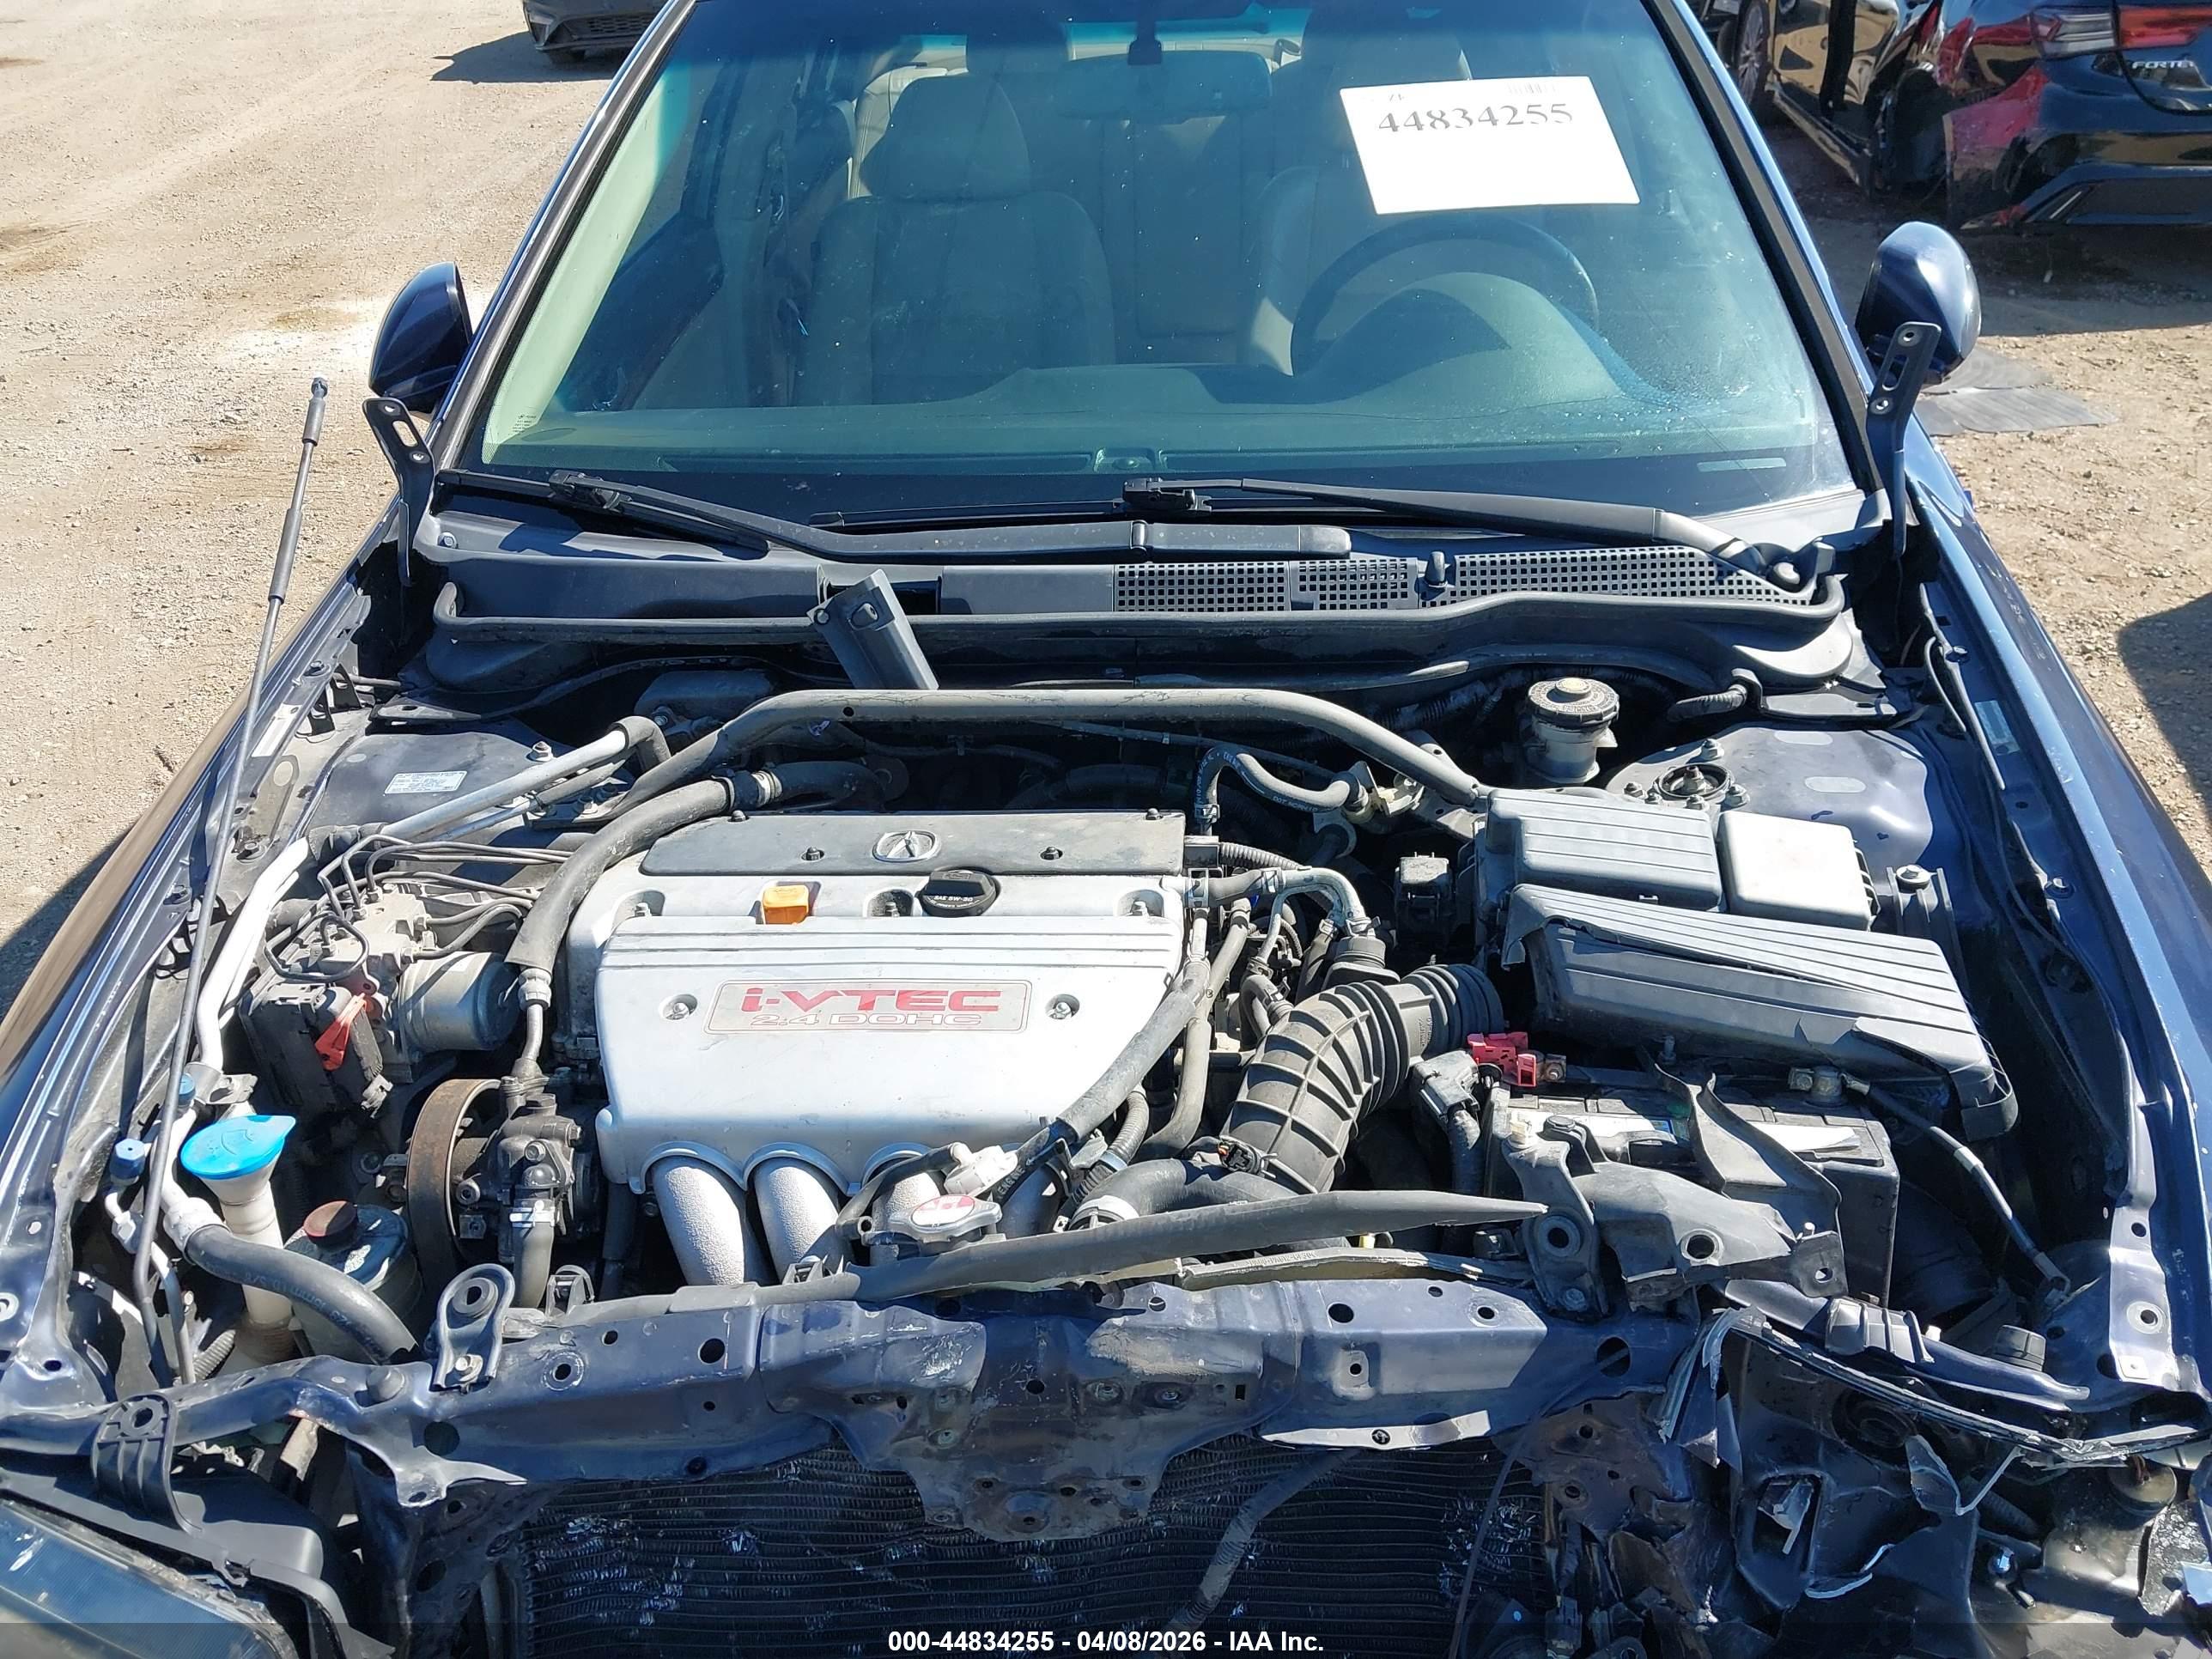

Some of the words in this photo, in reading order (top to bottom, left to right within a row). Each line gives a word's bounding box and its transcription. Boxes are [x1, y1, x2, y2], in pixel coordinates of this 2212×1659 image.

[1379, 103, 1573, 132] 44834255
[741, 988, 1002, 1012] i-VTEC
[750, 1013, 820, 1026] 2.4
[830, 1012, 982, 1025] DOHC
